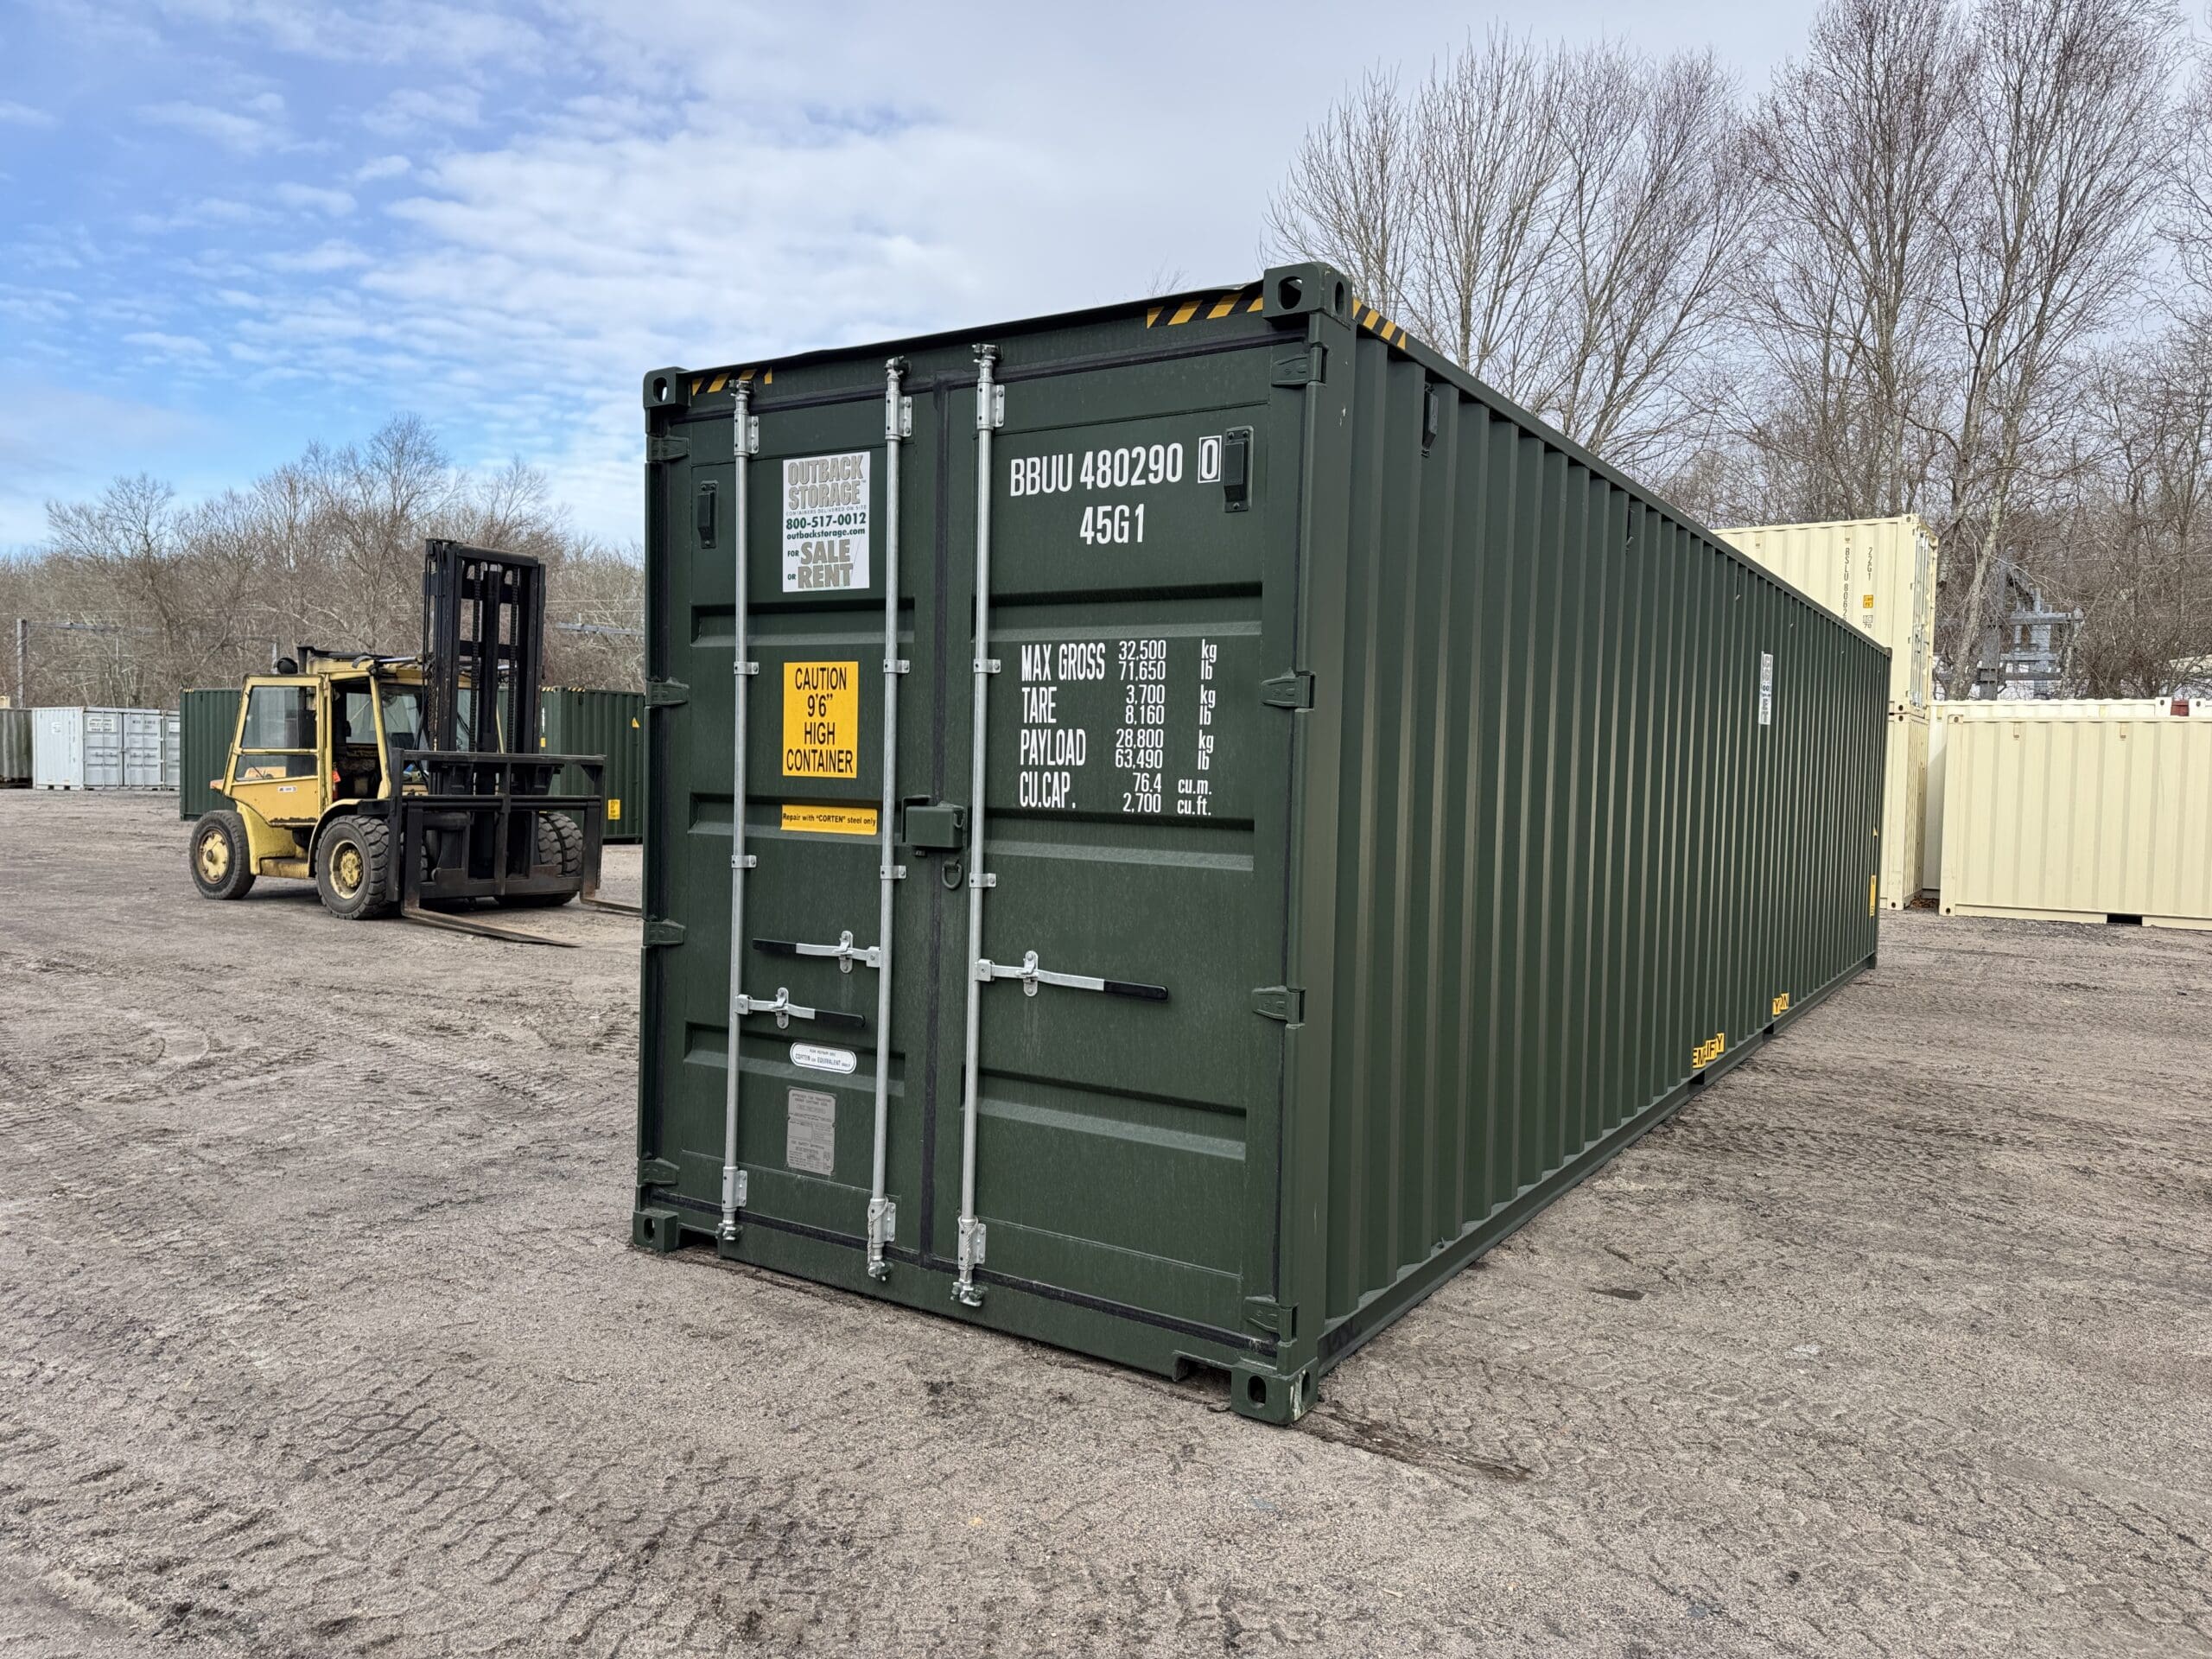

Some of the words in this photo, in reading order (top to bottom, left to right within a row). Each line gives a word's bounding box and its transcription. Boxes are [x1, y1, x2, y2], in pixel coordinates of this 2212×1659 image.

[787, 455, 864, 486] OUTBACK
[1010, 453, 1073, 497] BBUU
[1080, 442, 1183, 490] 480290
[1201, 438, 1218, 480] 0
[788, 480, 861, 509] STORAGE
[786, 512, 866, 530] 800-517-0012
[1080, 503, 1144, 544] 45G1
[786, 528, 866, 540] outbackstorage.com
[800, 538, 851, 565] SALE
[798, 563, 854, 589] RENT
[1021, 644, 1052, 682] MAX
[1058, 643, 1106, 681] GROSS
[1118, 639, 1166, 662] 32,500
[1201, 639, 1217, 664] kg
[1118, 660, 1166, 682] 71,650
[1200, 659, 1213, 681] lb
[795, 667, 847, 690] CAUTION
[1021, 686, 1058, 724] TARE
[1126, 684, 1165, 705] 3,700
[1199, 684, 1216, 709] kg
[1125, 704, 1165, 726] 8,160
[1199, 704, 1211, 726] lb
[804, 721, 836, 746] HIGH
[1020, 728, 1086, 766] PAYLOAD
[1116, 728, 1164, 750] 28,800
[1198, 729, 1214, 753] kg
[786, 748, 854, 773] CONTAINER
[1115, 749, 1163, 770] 63,490
[1198, 749, 1210, 771] lb
[1132, 772, 1161, 793] 76.4
[1178, 779, 1212, 795] cu.m.
[1122, 792, 1161, 814] 2,700
[1177, 795, 1211, 816] cu.ft.
[783, 813, 800, 822] Repair
[864, 817, 876, 826] only
